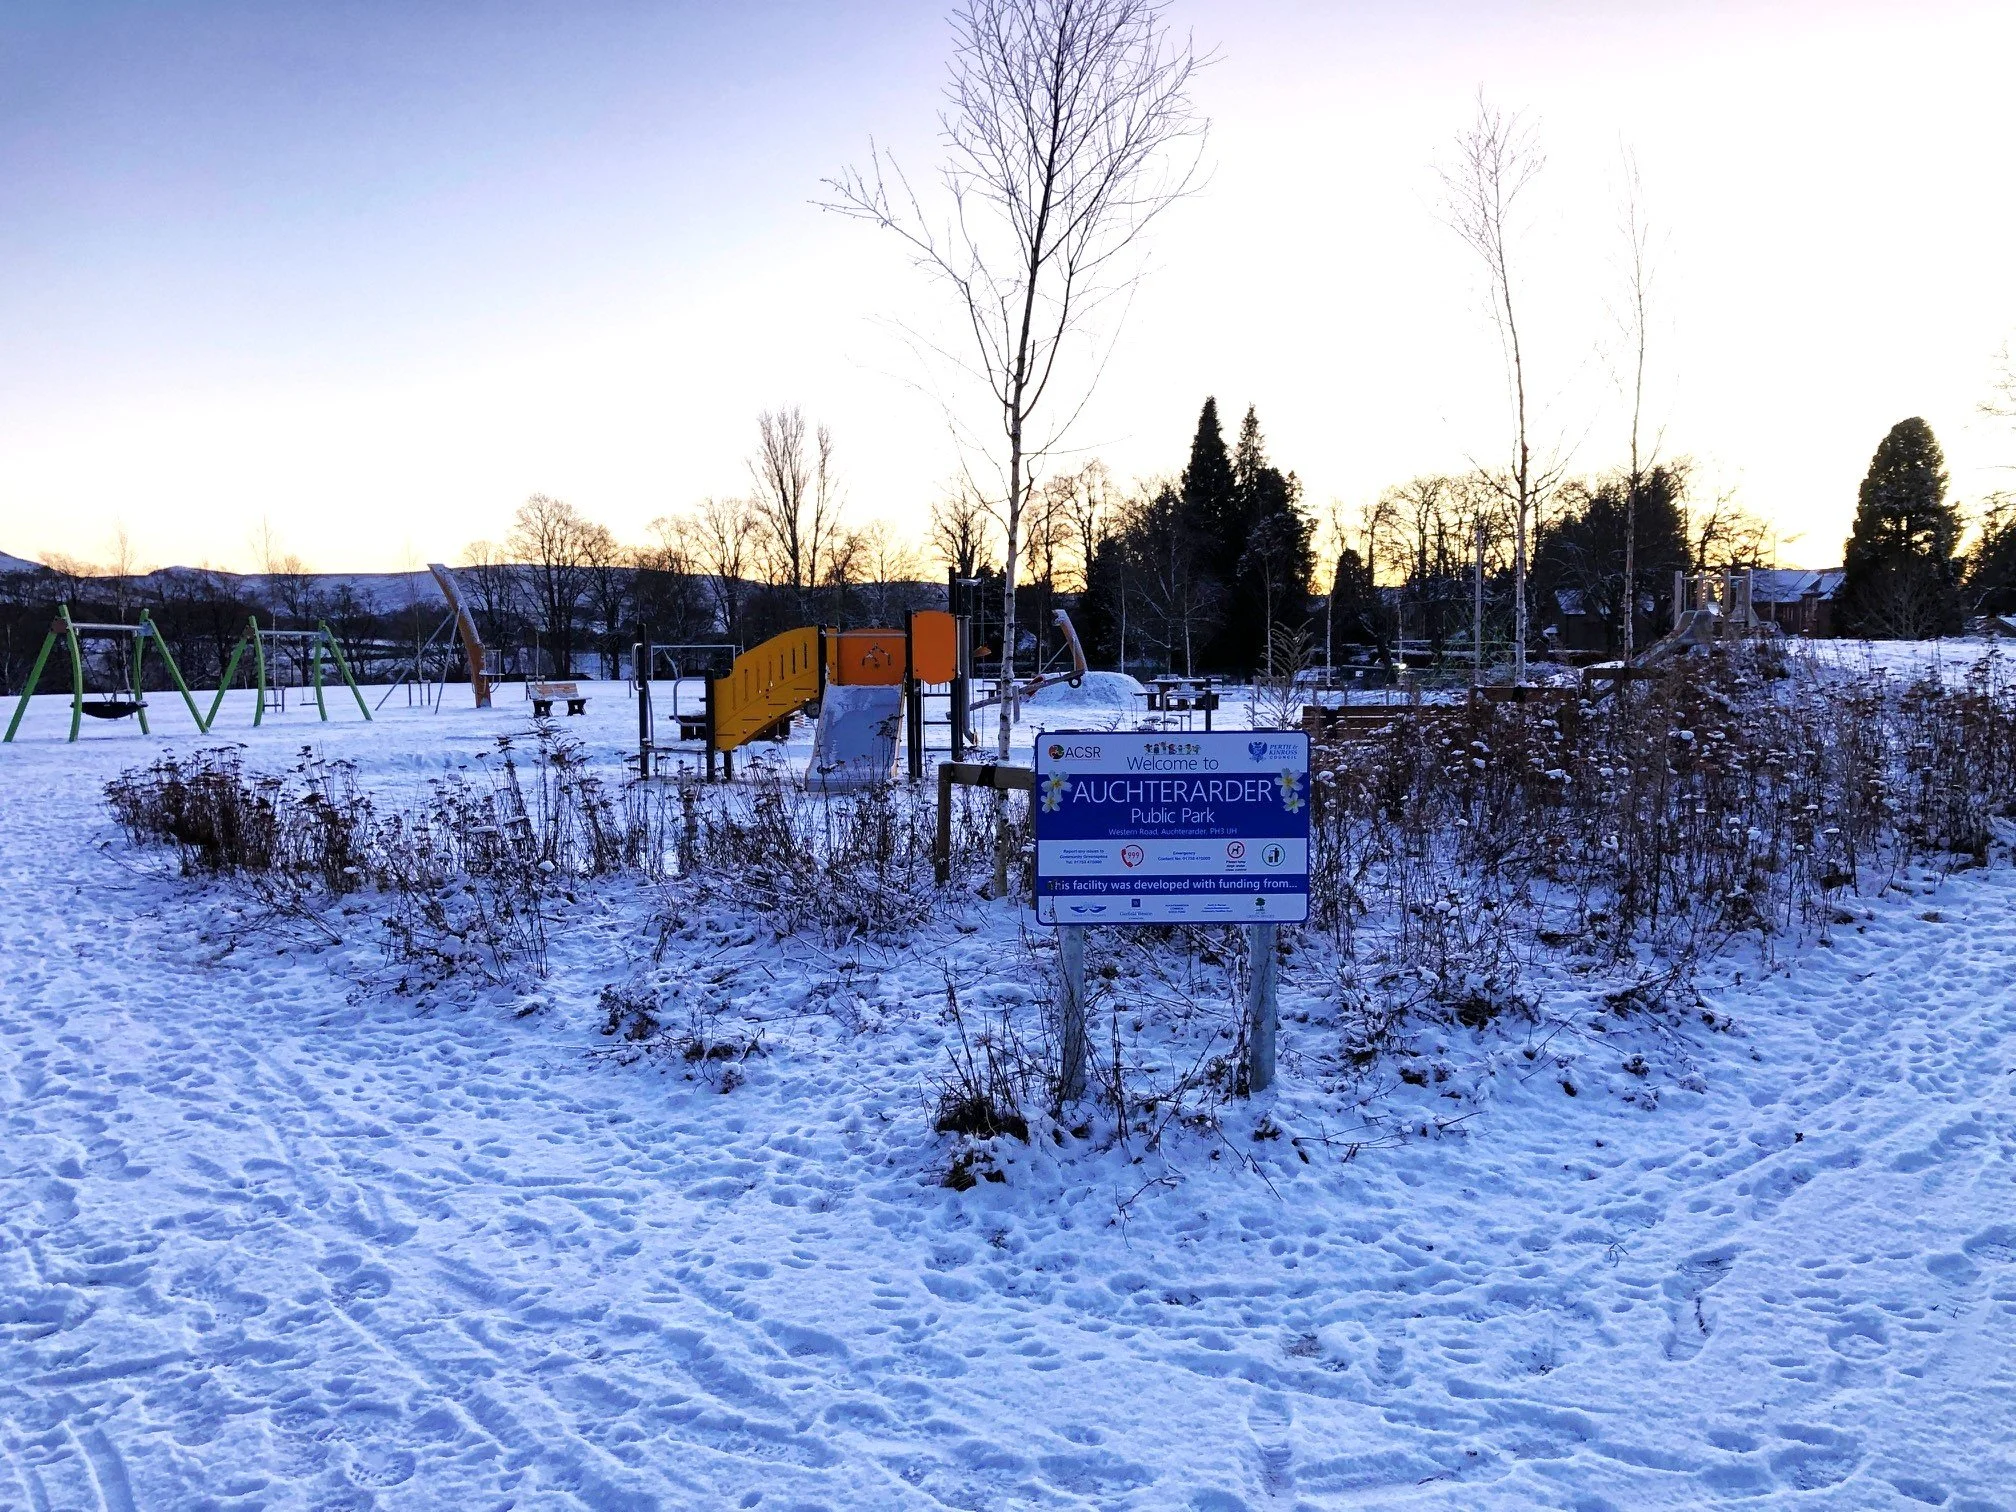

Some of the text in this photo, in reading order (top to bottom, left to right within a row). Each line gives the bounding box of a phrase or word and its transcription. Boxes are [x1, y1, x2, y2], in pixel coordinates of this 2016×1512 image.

[1065, 746, 1101, 759] ACSR
[1126, 756, 1219, 771] Welcome to
[1073, 780, 1272, 803] AUCHTERARDER
[1131, 806, 1215, 824] Public Park
[1108, 828, 1138, 836] Western
[1209, 827, 1225, 835] PH3
[1073, 880, 1108, 892] facility
[1111, 882, 1131, 890] was
[1134, 879, 1190, 891] developed
[1192, 879, 1216, 889] with
[1219, 878, 1260, 890] funding
[1263, 878, 1298, 888] from...
